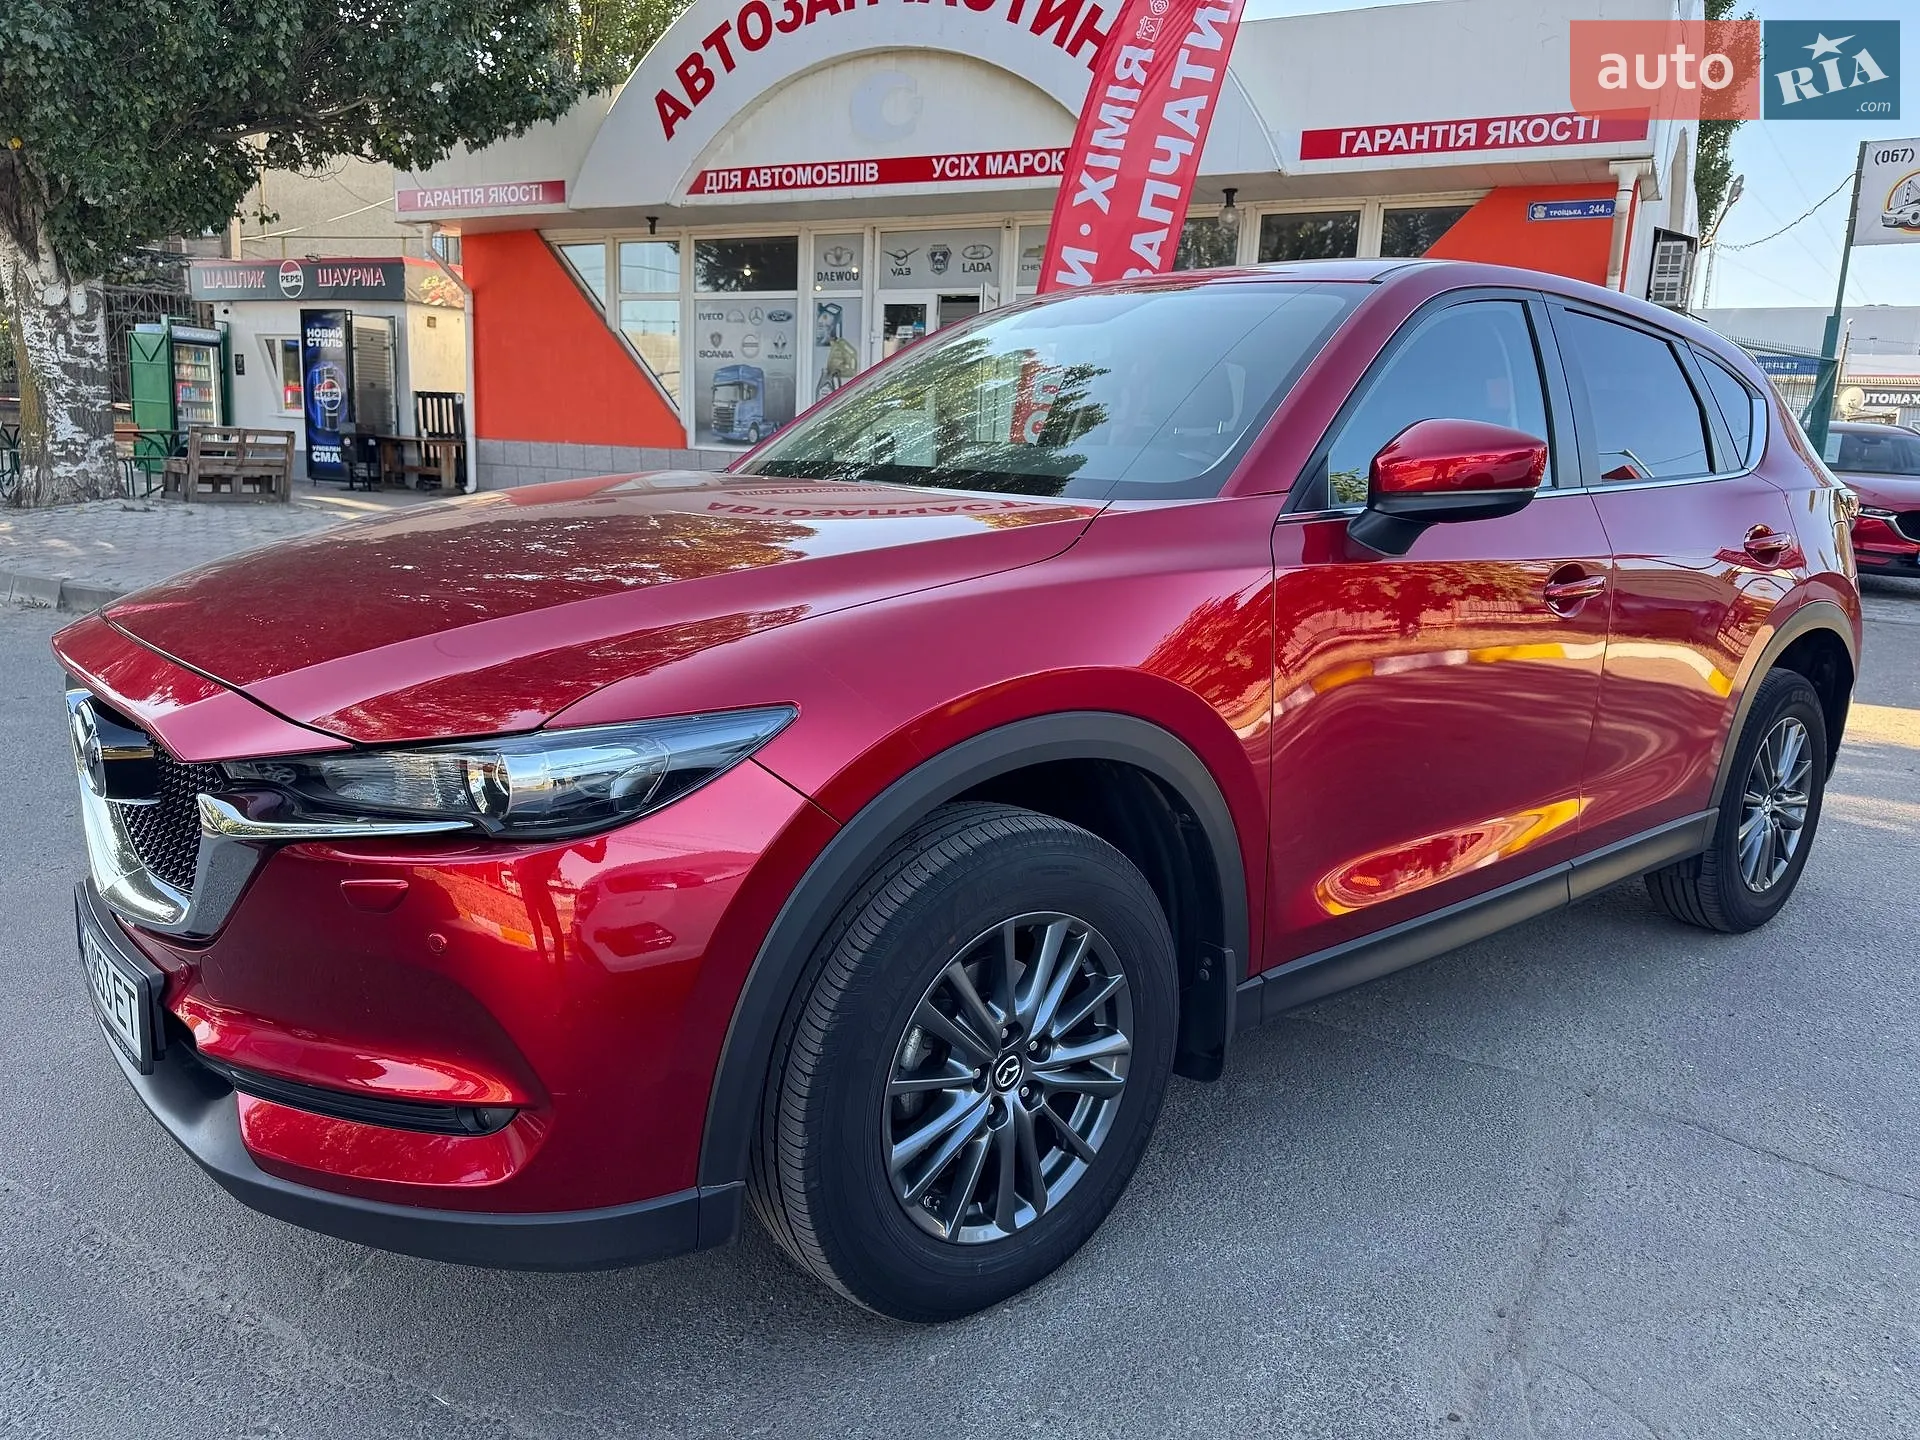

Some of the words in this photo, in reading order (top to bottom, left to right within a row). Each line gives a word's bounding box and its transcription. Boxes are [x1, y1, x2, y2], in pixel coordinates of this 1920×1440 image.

[1072, 45, 1156, 216] ХІМІЯ
[1339, 122, 1478, 154] ГАРАНТІЯ
[1484, 114, 1601, 145] ЯКОСТІ
[1874, 147, 1915, 166] (067)
[703, 170, 742, 194] ДЛЯ
[746, 162, 879, 188] АВТОМОБІЛІВ
[931, 155, 980, 178] УСІХ
[985, 151, 1066, 176] МАРОК
[417, 187, 484, 208] ГАРАНТІЯ
[488, 183, 543, 203] ЯКОСТІ
[1588, 204, 1604, 214] 244
[961, 262, 993, 273] LADA
[201, 269, 267, 288] ШАШЛИК
[280, 274, 303, 283] PEPSI
[317, 267, 387, 287] ШАУРМА
[817, 271, 860, 282] DAEWOO
[698, 312, 724, 321] IVECO
[306, 327, 343, 338] НОВИЙ
[306, 338, 344, 348] СТИЛЬ
[698, 350, 735, 359] SCANIA
